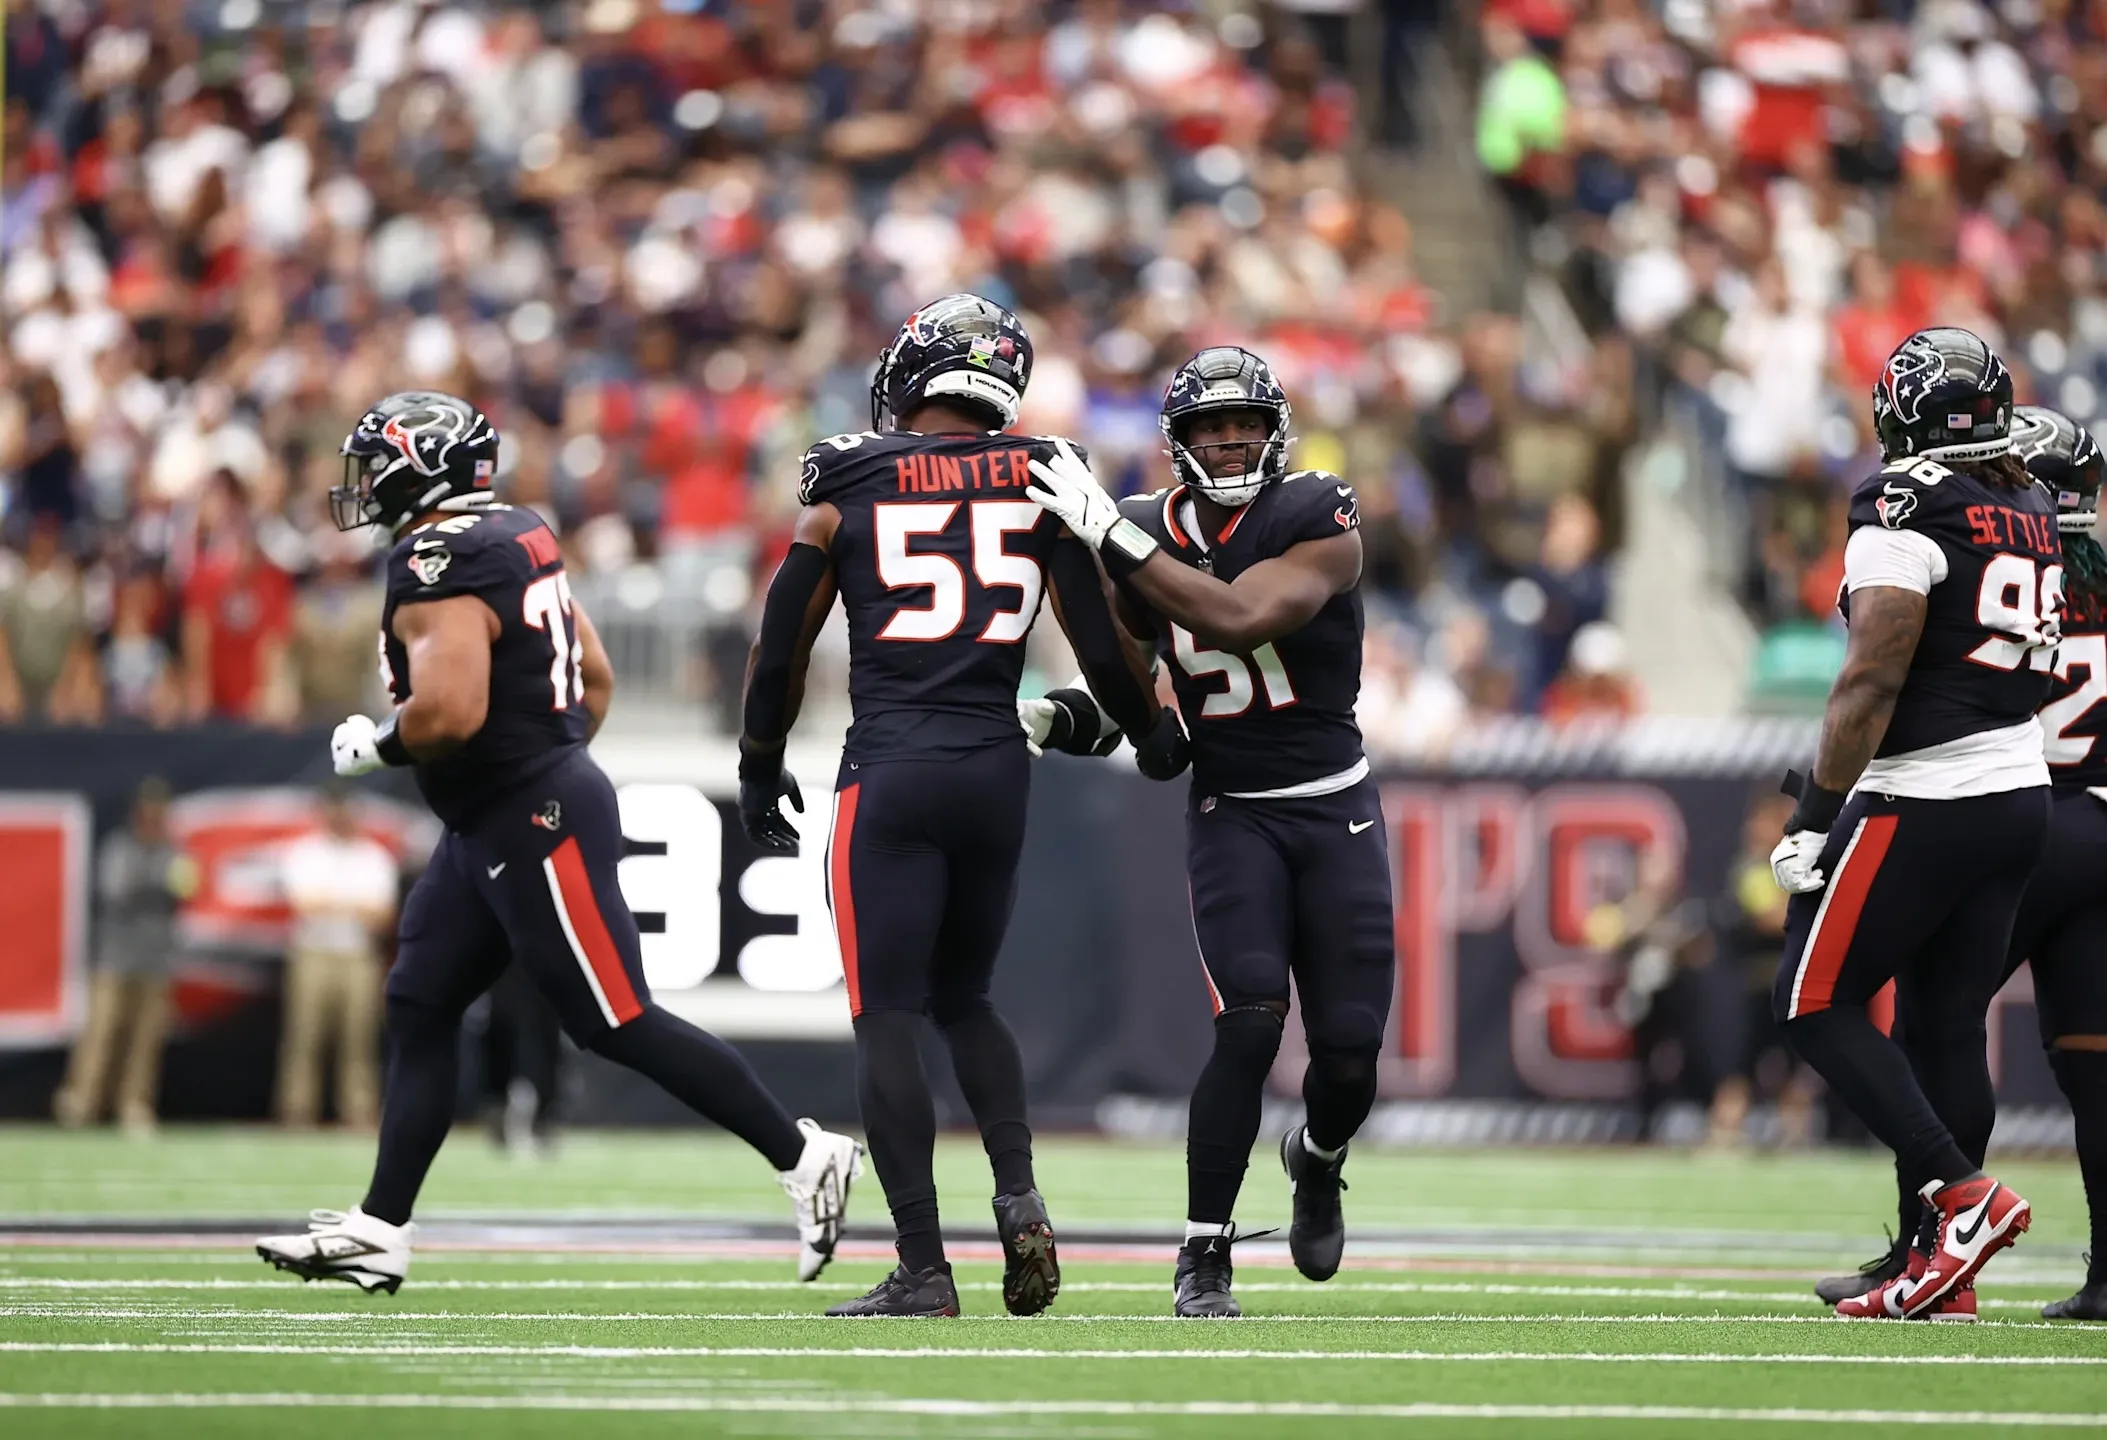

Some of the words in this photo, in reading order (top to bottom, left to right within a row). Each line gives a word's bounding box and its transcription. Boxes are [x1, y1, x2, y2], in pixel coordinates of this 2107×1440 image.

[975, 378, 1011, 396] HOUSTON
[896, 450, 1031, 493] HUNTER
[1965, 505, 2054, 555] SETTLE
[873, 499, 1048, 645] 55
[1169, 619, 1299, 720] 51
